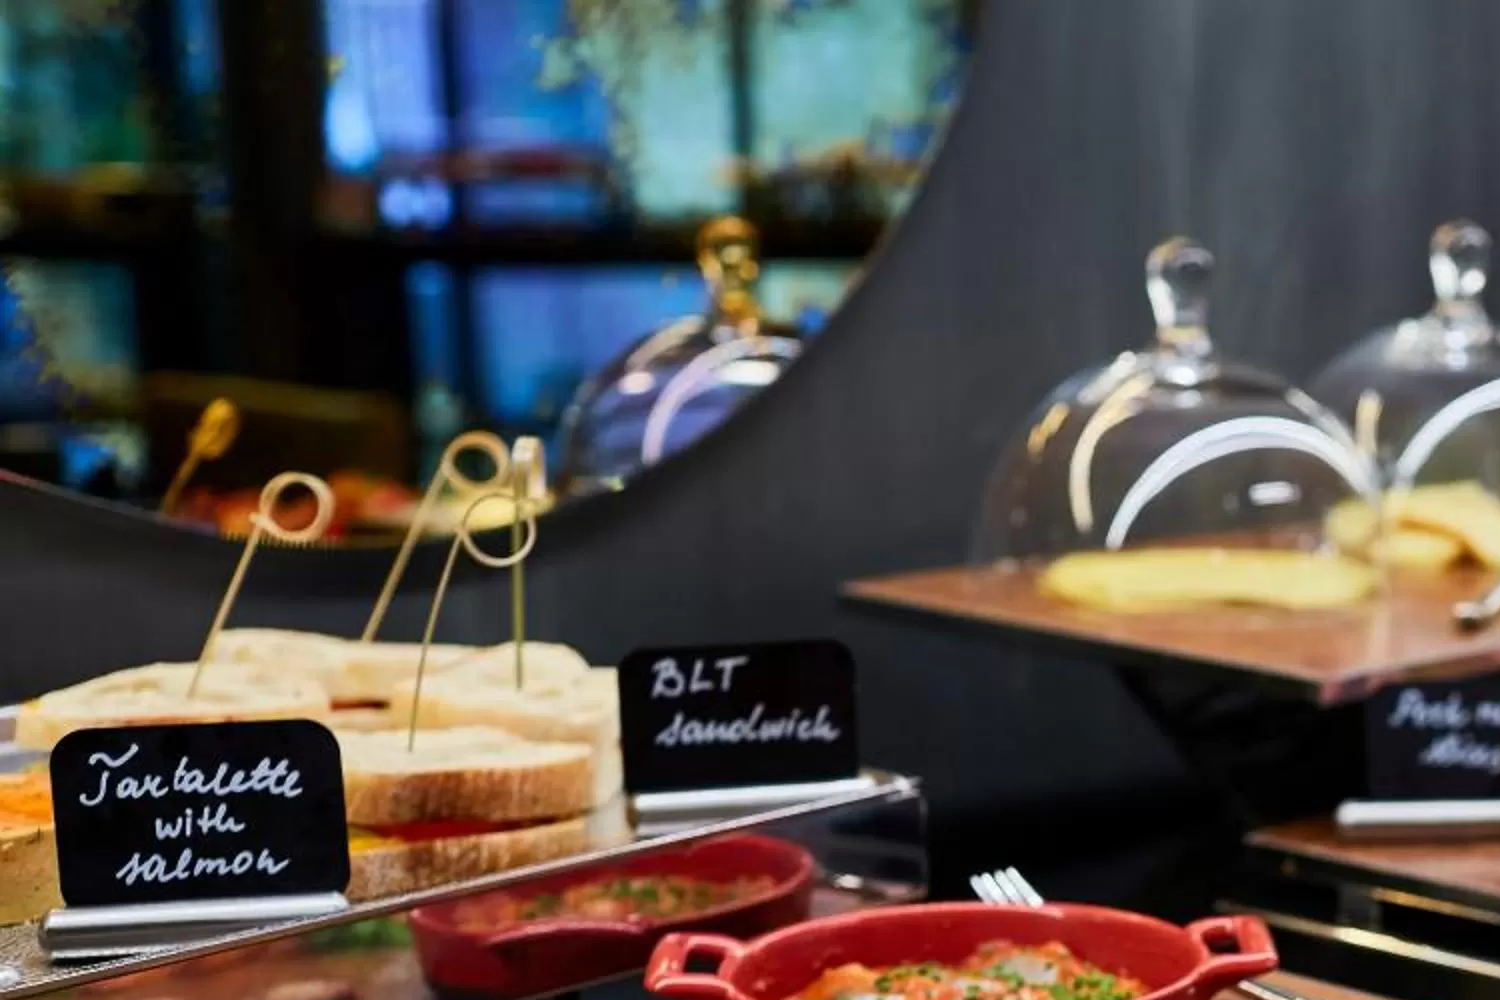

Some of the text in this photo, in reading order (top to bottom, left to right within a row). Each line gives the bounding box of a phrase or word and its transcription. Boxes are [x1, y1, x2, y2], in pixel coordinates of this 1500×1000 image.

[651, 656, 748, 698] BLT
[655, 704, 840, 746] sandwich
[79, 743, 303, 806] Tartalette
[155, 803, 245, 840] with
[115, 847, 289, 886] salmon
